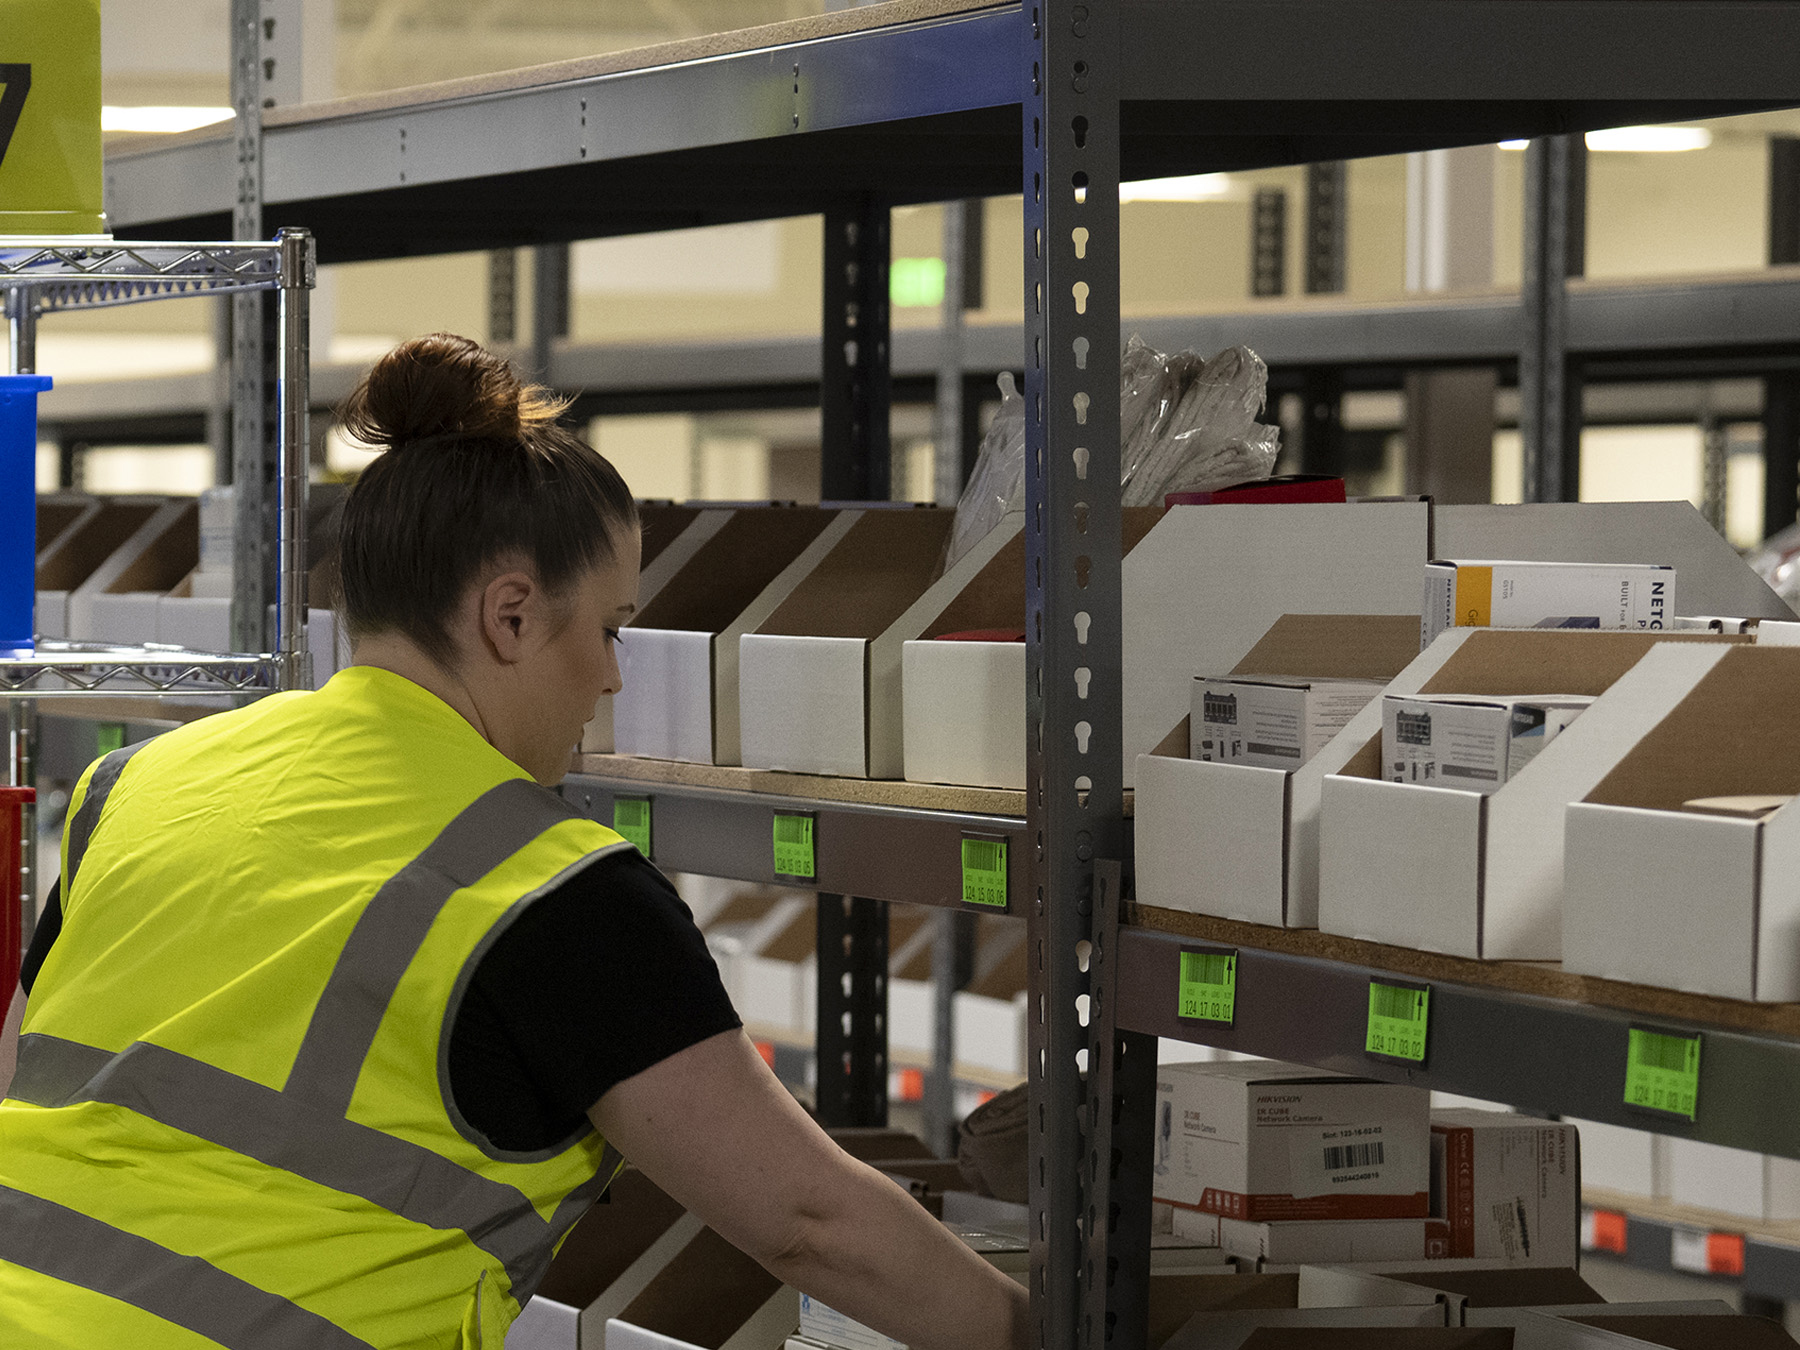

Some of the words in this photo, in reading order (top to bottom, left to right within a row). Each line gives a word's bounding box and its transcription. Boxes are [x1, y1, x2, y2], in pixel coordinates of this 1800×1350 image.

[1620, 581, 1629, 608] BUILT
[965, 885, 975, 899] 124
[978, 887, 985, 901] 15
[987, 888, 995, 903] 03
[997, 890, 1004, 904] 06
[1185, 1000, 1197, 1015] 124
[1200, 1001, 1208, 1017] 17
[1211, 1002, 1220, 1018] 03
[1223, 1003, 1231, 1020] 01
[1372, 1034, 1385, 1051] 124
[1387, 1036, 1396, 1053] 17
[1399, 1038, 1409, 1056] 03
[1411, 1041, 1421, 1058] 02
[1257, 1095, 1302, 1104] HIKVISION
[1268, 1107, 1290, 1115] CUBE
[1257, 1115, 1291, 1123] Network
[1322, 1131, 1339, 1139] Slot:
